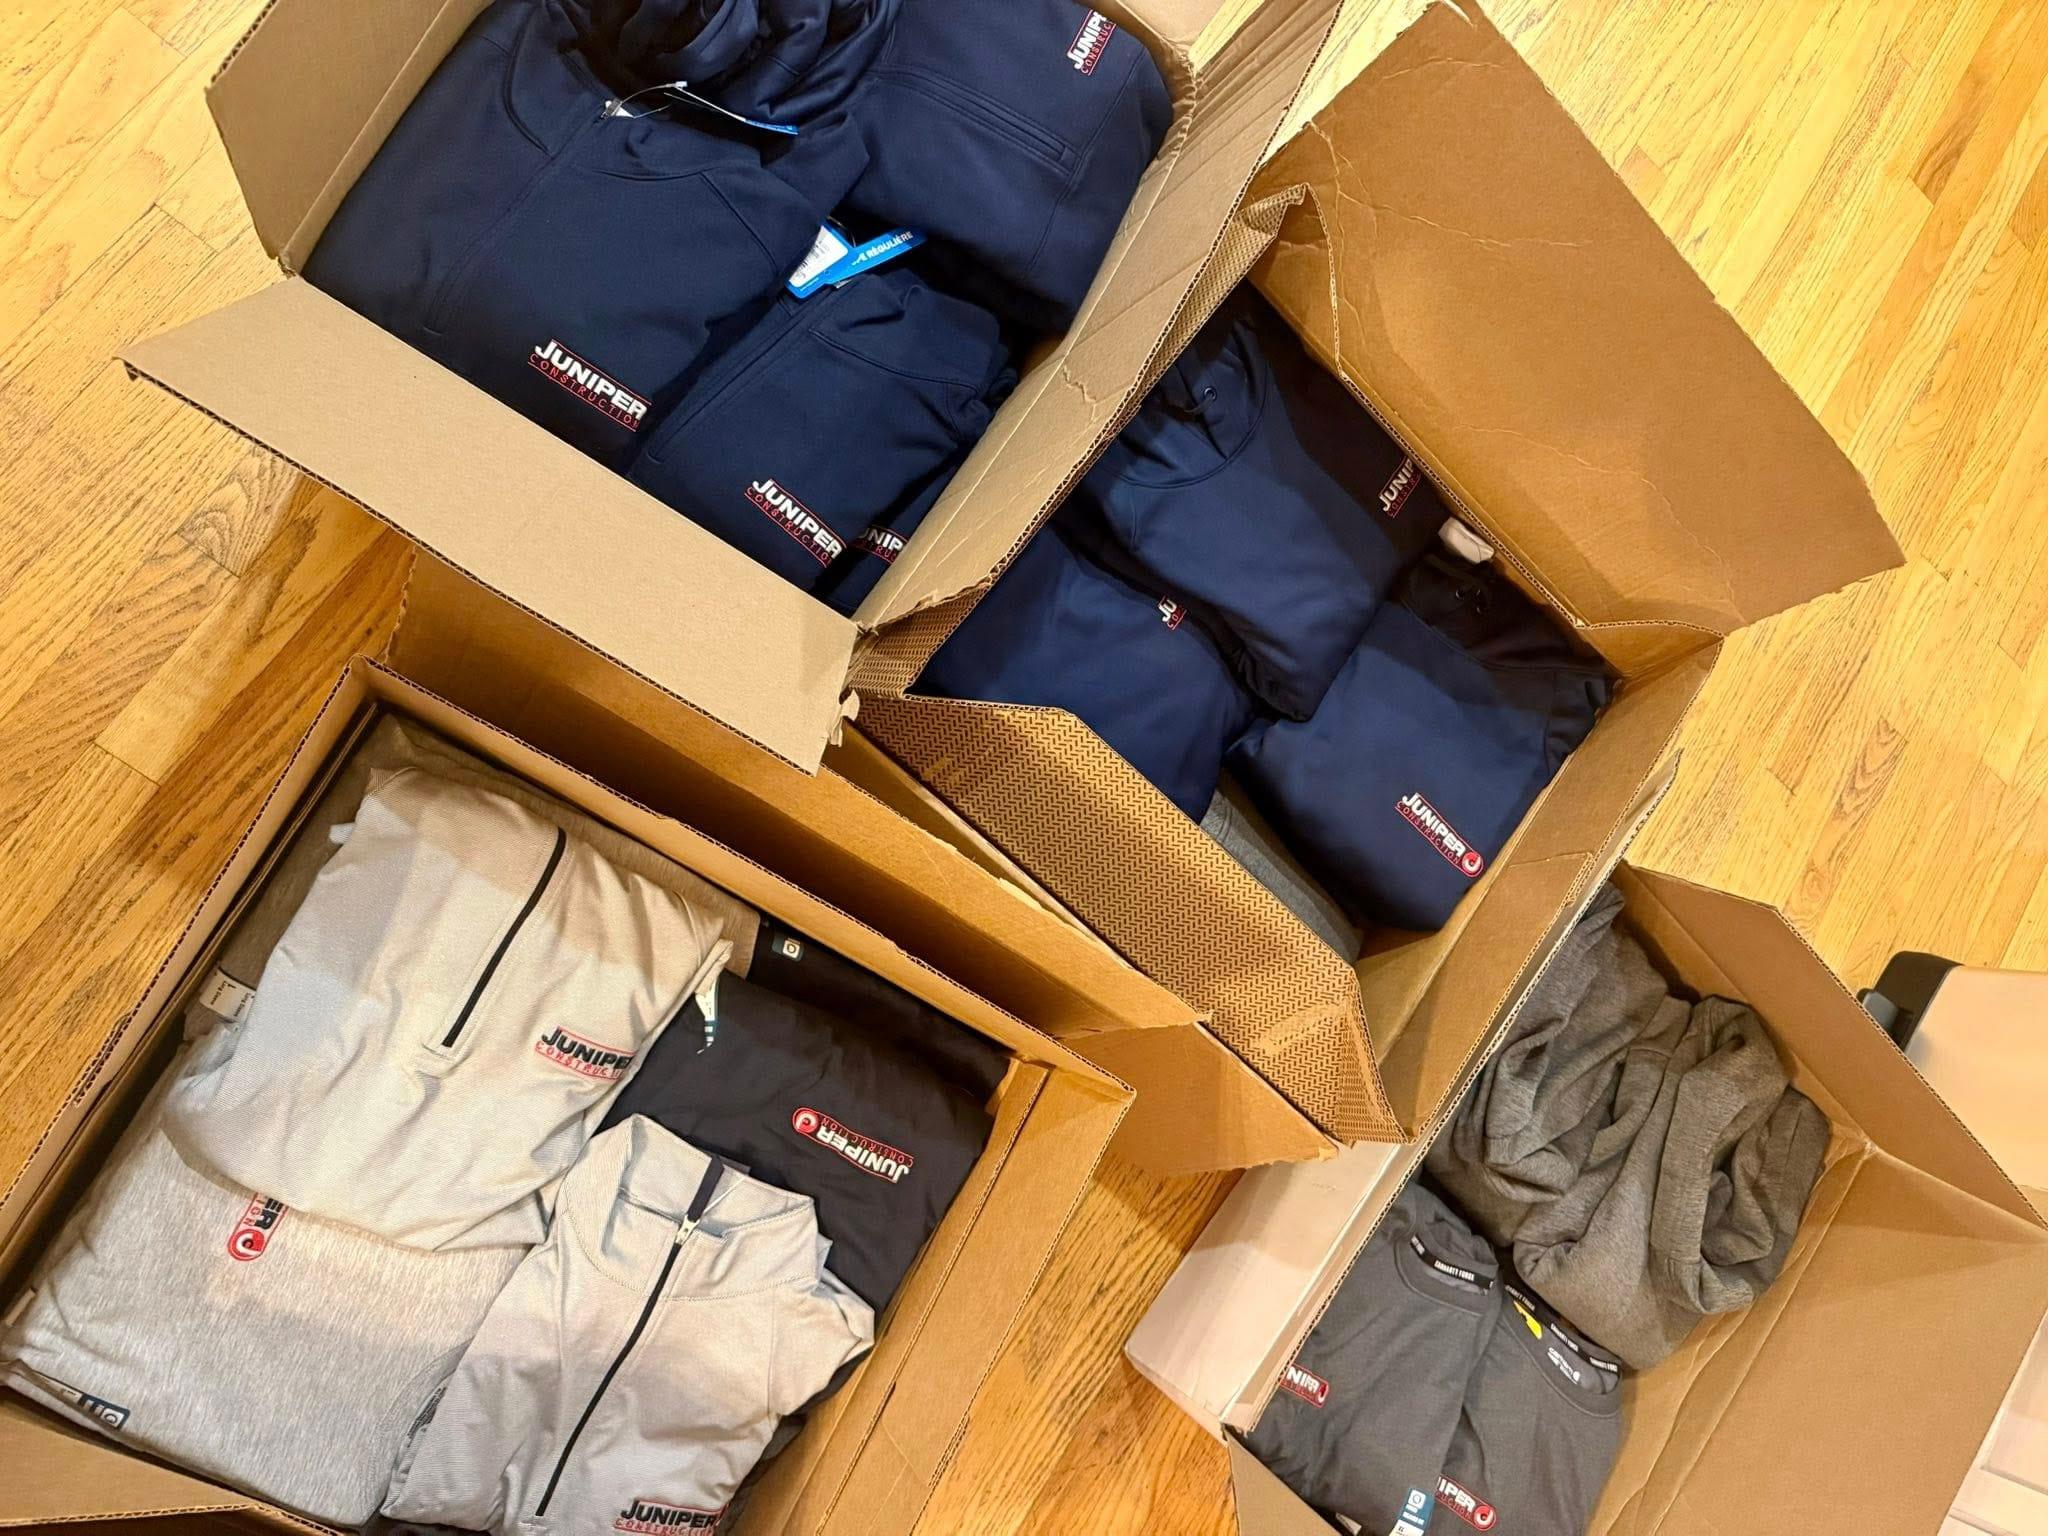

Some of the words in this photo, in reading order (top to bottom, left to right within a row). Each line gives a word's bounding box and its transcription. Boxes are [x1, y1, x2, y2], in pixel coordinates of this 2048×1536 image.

[1067, 11, 1107, 69] JUNIP
[534, 340, 648, 421] JUNIPER
[1379, 458, 1414, 512] JUNIP
[751, 478, 843, 560] JUNIPER
[1396, 800, 1461, 865] CONSTRUCTION
[1402, 792, 1466, 858] JUNIPER
[541, 1027, 634, 1070] JUNIPE
[816, 1125, 909, 1184] JUNIPER
[820, 1117, 914, 1168] CONSTRUCTION
[1439, 1478, 1477, 1513] IPER
